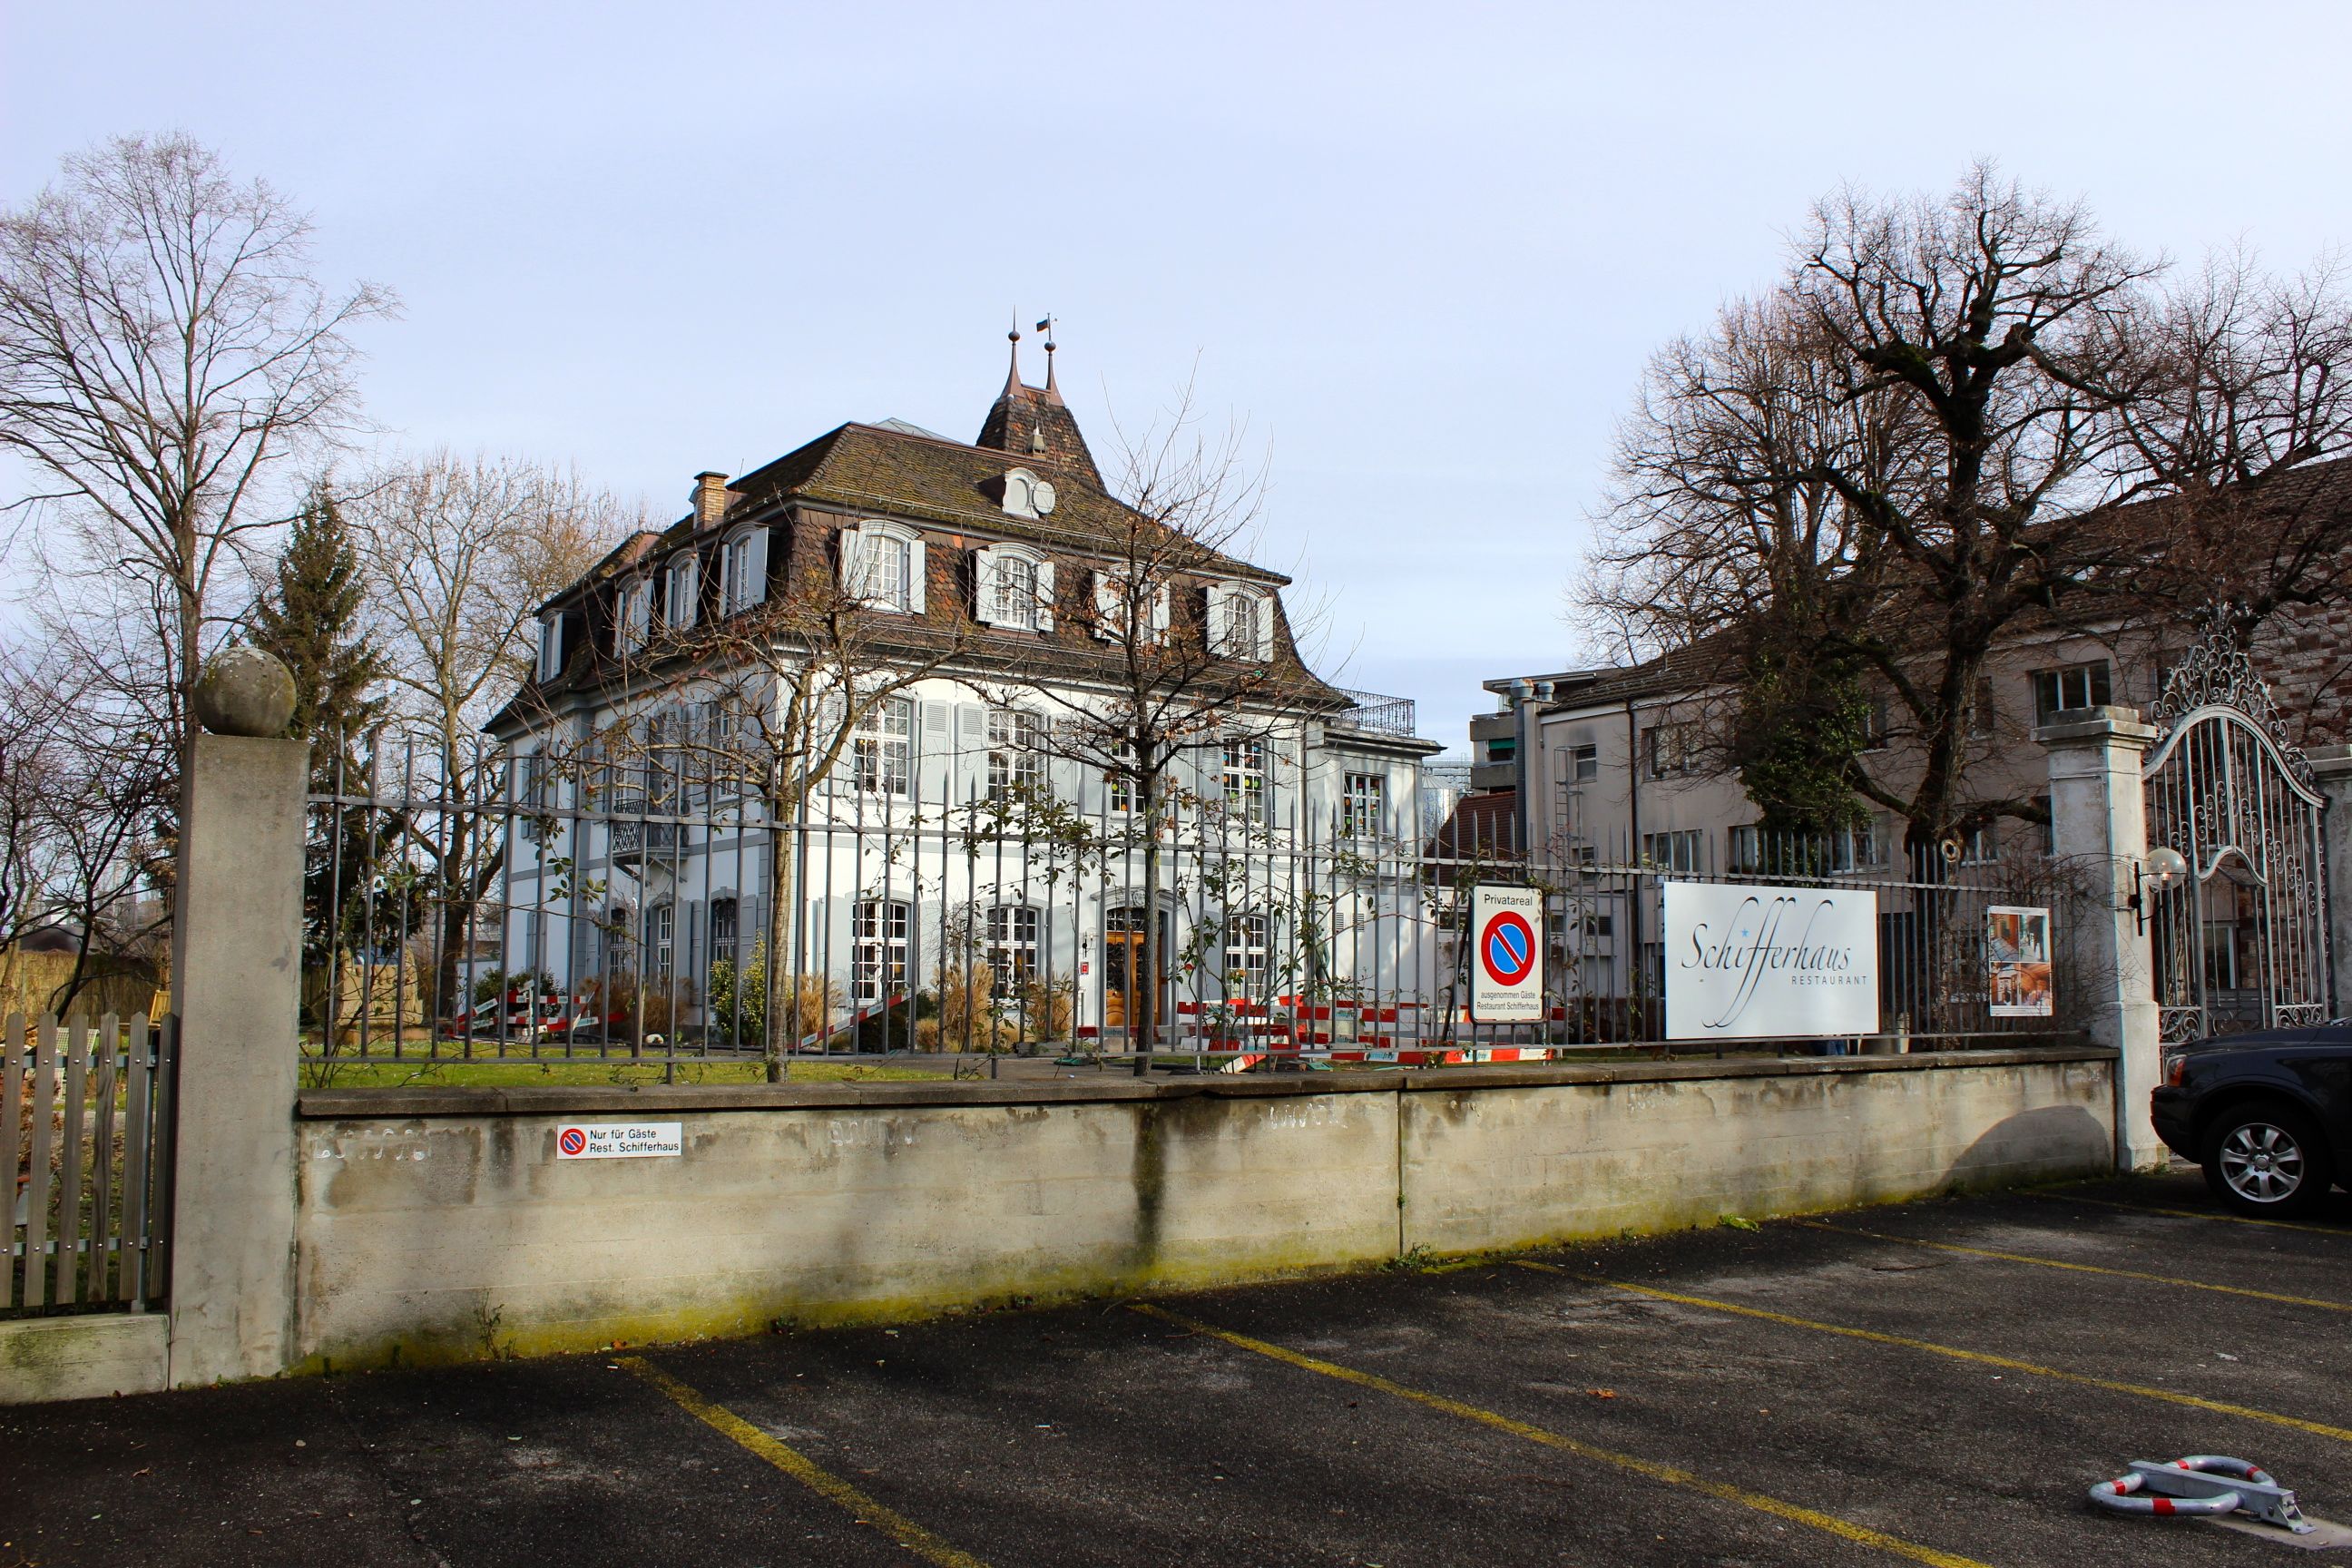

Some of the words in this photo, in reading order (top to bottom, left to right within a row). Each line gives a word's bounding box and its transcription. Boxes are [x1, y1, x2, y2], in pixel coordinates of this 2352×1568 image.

[1484, 893, 1533, 906] Privatareal
[1681, 896, 1851, 1028] Schifferhaus
[1791, 975, 1867, 985] RESTAURANT
[1480, 992, 1519, 1001] ausgenommen
[1520, 990, 1536, 999] Gäste
[1476, 1001, 1506, 1010] Restaurant
[1506, 1001, 1540, 1010] Schifferhaus
[590, 1130, 607, 1140] Nur
[611, 1129, 624, 1139] für
[628, 1128, 657, 1139] Gäste
[590, 1142, 614, 1153] Rest.
[619, 1142, 679, 1152] Schifferhaus
